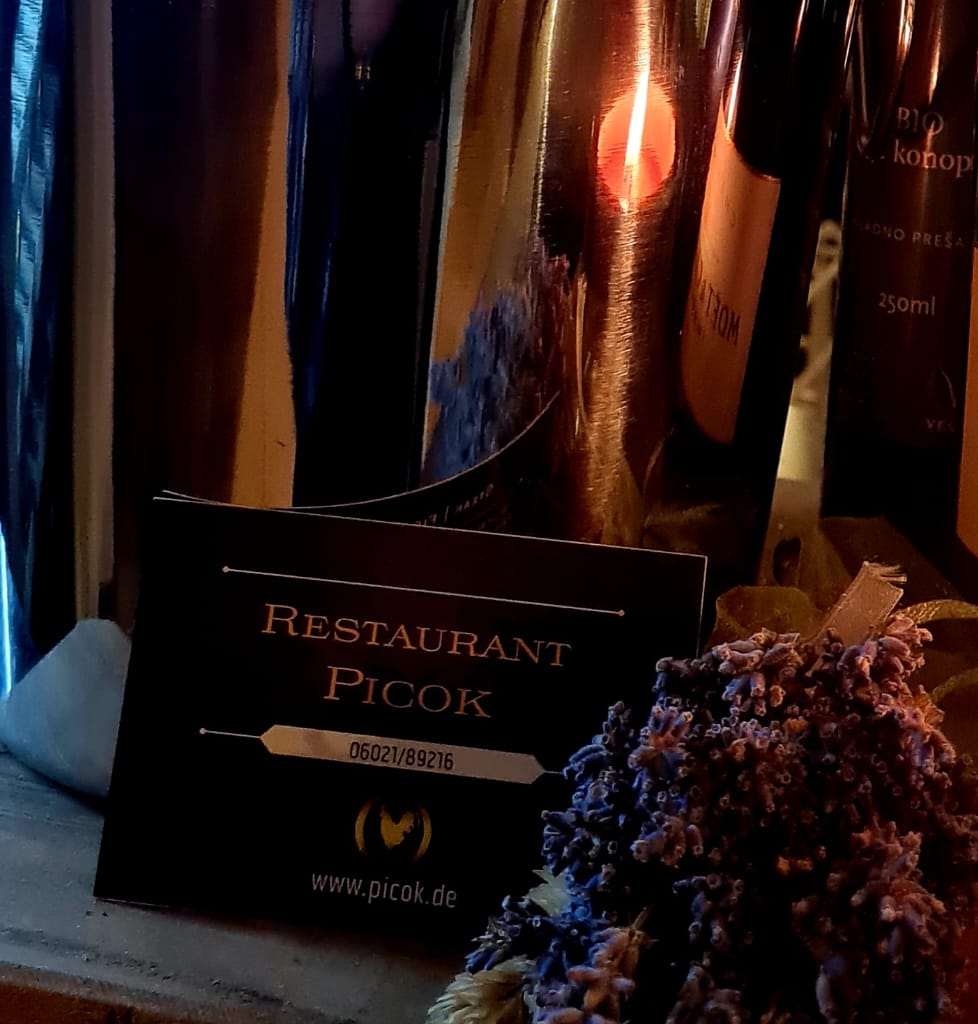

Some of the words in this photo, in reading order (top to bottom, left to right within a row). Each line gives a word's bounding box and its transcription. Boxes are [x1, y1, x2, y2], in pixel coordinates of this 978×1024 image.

[878, 292, 937, 318] 250ml
[349, 741, 454, 772] 06021/89216
[311, 872, 458, 909] www.picok.de
